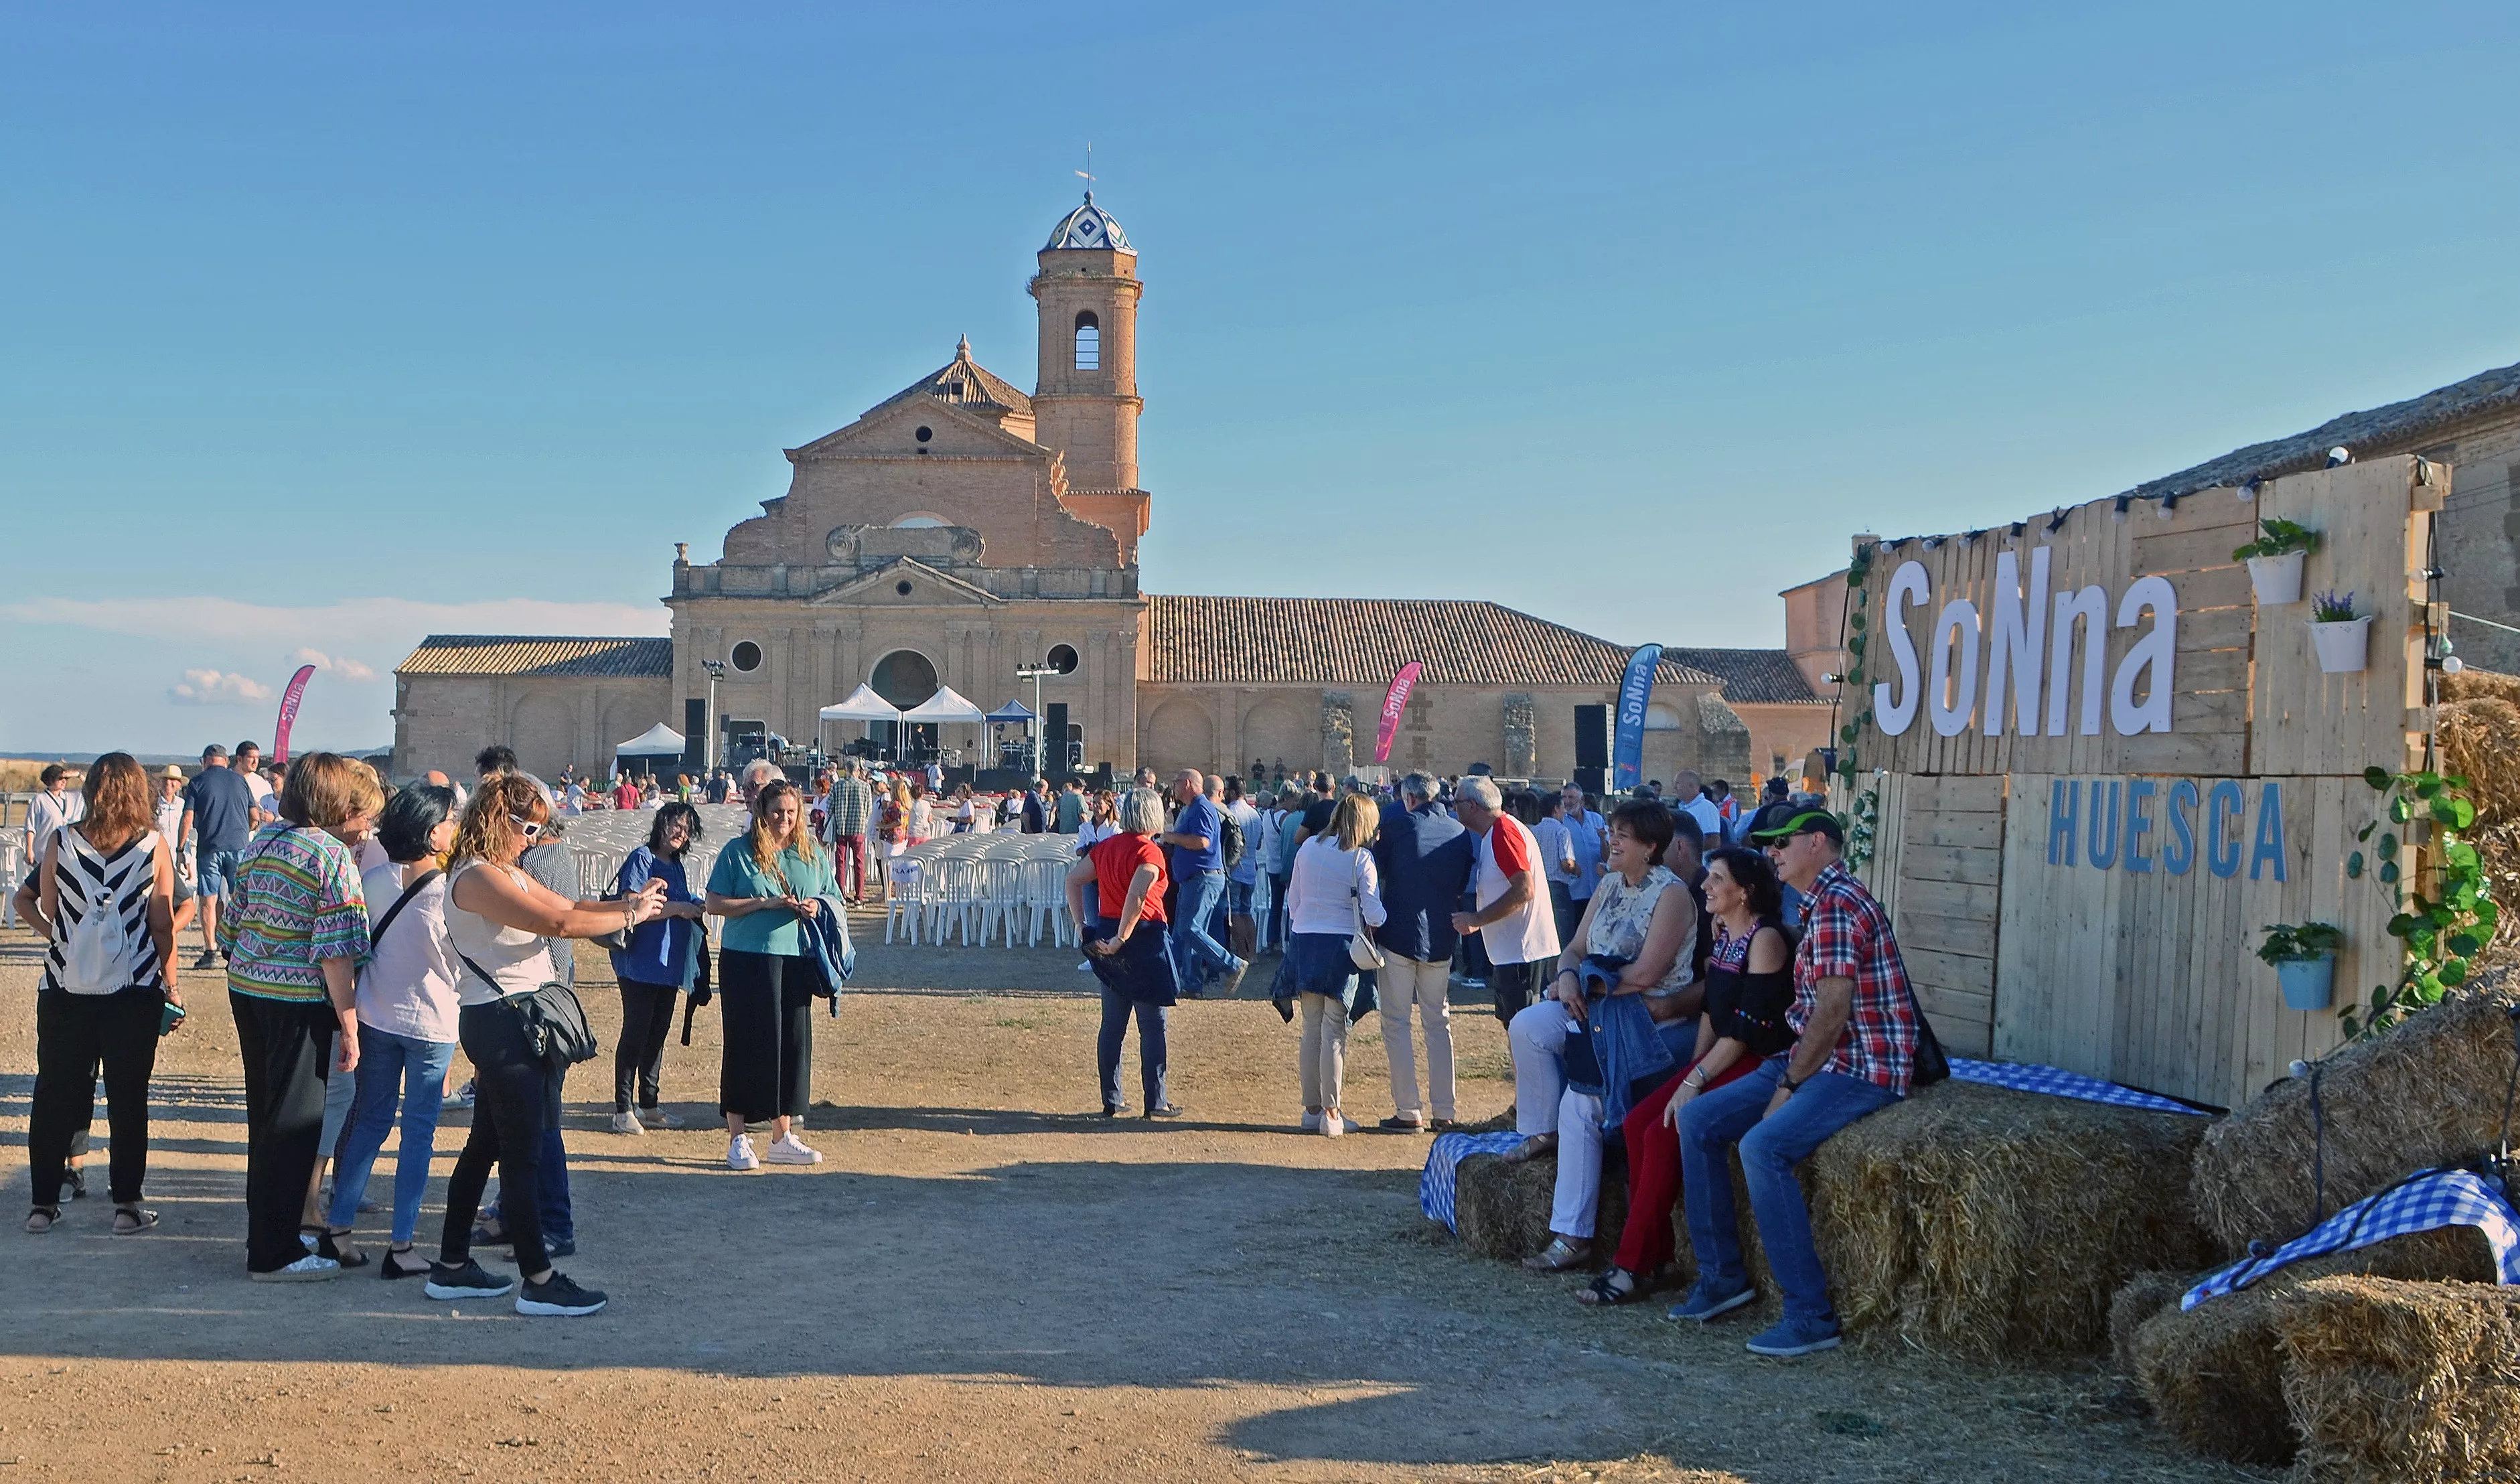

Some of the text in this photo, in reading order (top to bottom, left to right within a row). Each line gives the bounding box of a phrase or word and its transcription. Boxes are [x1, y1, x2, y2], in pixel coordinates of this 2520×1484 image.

[1874, 546, 2177, 735] SoNna
[1384, 678, 1410, 719] SoNna
[1623, 664, 1647, 727] SoNna
[2048, 780, 2286, 882] HUESCA
